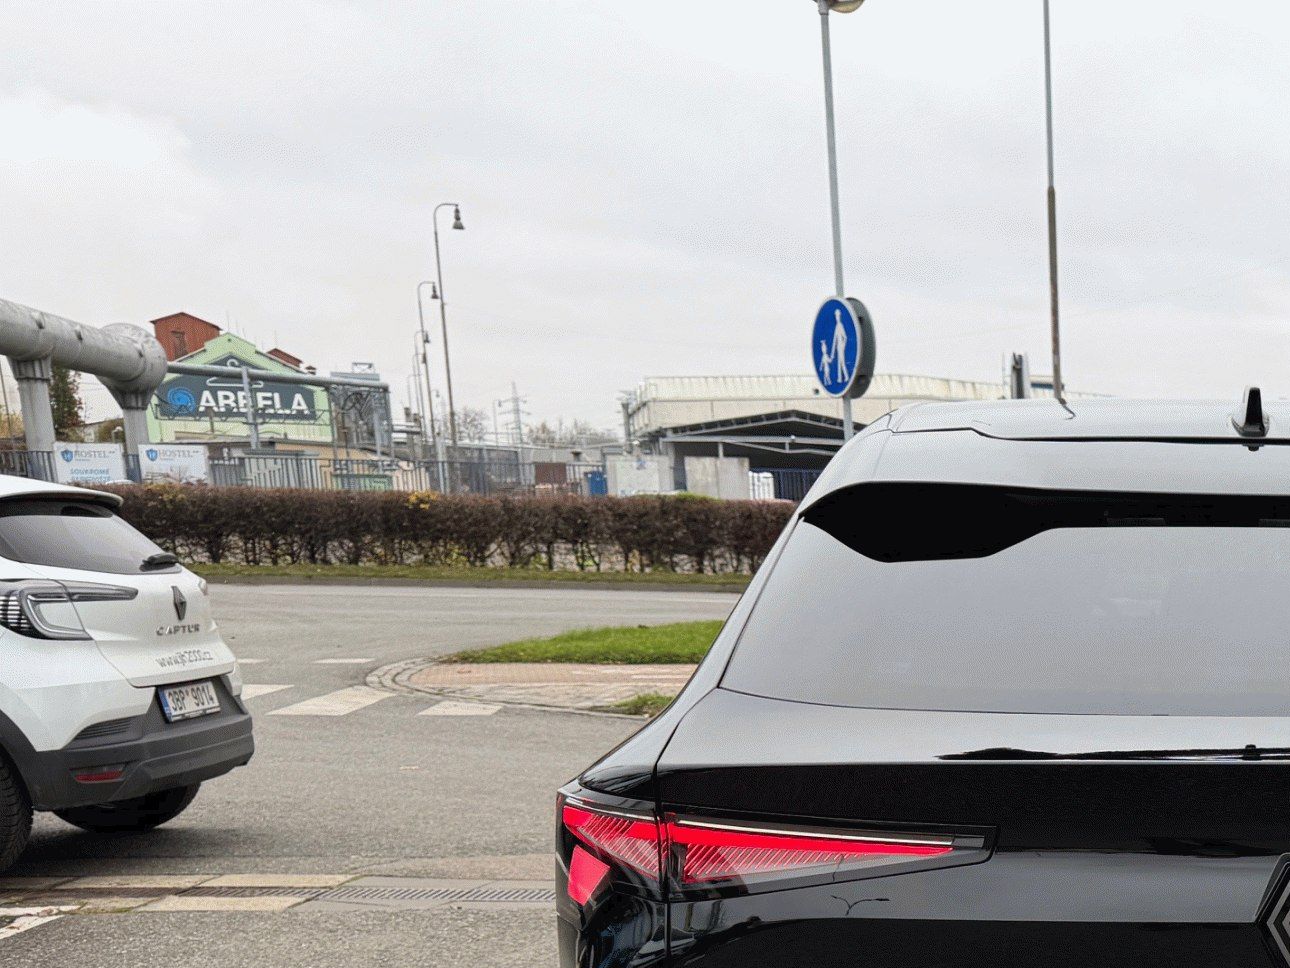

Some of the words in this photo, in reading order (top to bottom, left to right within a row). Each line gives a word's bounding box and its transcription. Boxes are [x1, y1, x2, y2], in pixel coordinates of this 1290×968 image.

[156, 624, 200, 636] CAPTUR
[168, 689, 187, 711] 3BP
[191, 684, 214, 707] 9014
